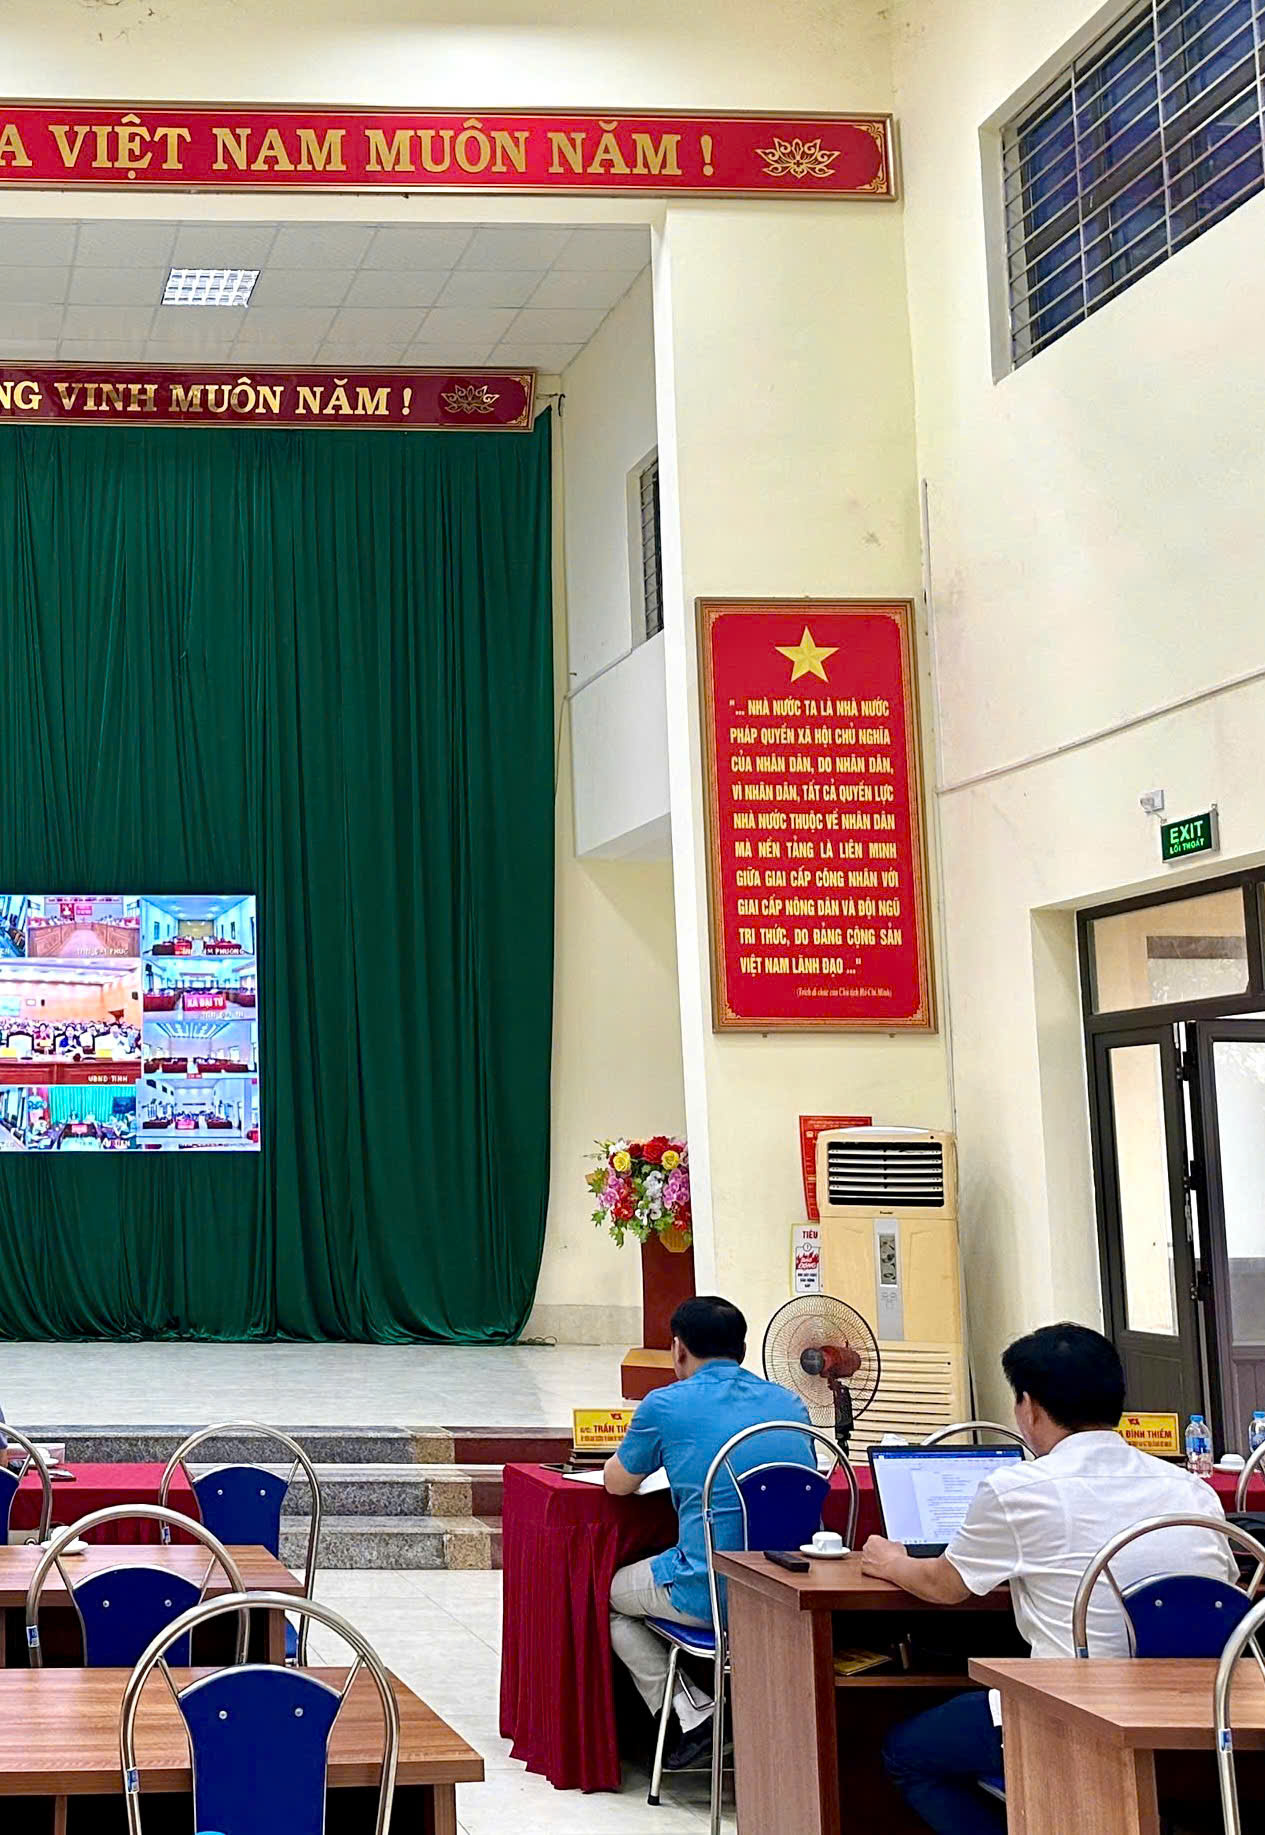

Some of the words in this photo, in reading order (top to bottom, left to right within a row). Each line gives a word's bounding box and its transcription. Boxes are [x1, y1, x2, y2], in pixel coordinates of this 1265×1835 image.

[48, 113, 191, 179] VIỆT
[212, 127, 346, 172] NAM
[365, 119, 530, 174] MUÔN
[547, 120, 682, 177] NĂM
[701, 135, 713, 177] !
[54, 381, 157, 413] VINH
[168, 376, 283, 415] MUÔN
[294, 377, 391, 416] NĂM
[402, 388, 412, 416] !
[748, 697, 770, 716] NHÀ
[773, 696, 801, 716] NƯỚC
[804, 700, 817, 716] TA
[820, 697, 833, 716] LÀ
[837, 697, 858, 716] NHÀ
[861, 697, 889, 716] NƯỚC
[730, 725, 757, 744] PHÁP
[798, 726, 812, 744] XÃ
[815, 725, 832, 747] HỘI
[835, 722, 855, 744] CHỦ
[859, 726, 891, 745] NGHĨA
[731, 750, 752, 772] CỦA
[756, 753, 785, 772] NHÂN
[789, 753, 814, 774] DÂN,
[818, 757, 832, 772] DO
[836, 754, 865, 773] NHÂN
[745, 782, 773, 800] NHÂN
[776, 783, 800, 802] DÂN,
[823, 778, 835, 801] CẢ
[874, 784, 894, 804] LỰC
[734, 810, 755, 829] NHÀ
[758, 810, 787, 829] NƯỚC
[790, 811, 823, 832] THUỘC
[841, 811, 870, 829] NHÂN
[874, 811, 895, 830] DÂN
[1170, 821, 1203, 844] EXIT
[735, 838, 752, 857] MÀ
[787, 835, 814, 858] TẢNG
[820, 839, 833, 858] LÀ
[839, 839, 863, 858] LIÊN
[869, 842, 897, 858] MINH
[737, 867, 761, 886] GIỮA
[765, 871, 786, 887] GIAI
[848, 868, 878, 887] NHÂN
[881, 867, 899, 887] VỚI
[738, 899, 759, 915] GIAI
[786, 897, 814, 916] NÔNG
[818, 897, 839, 916] DÂN
[842, 897, 856, 916] VÀ
[858, 897, 875, 919] ĐỘI
[878, 898, 900, 916] NGŨ
[739, 928, 755, 944] TRI
[760, 924, 790, 947] THỨC,
[795, 929, 808, 944] DO
[813, 922, 842, 944] ĐẢNG
[847, 926, 875, 948] CỘNG
[880, 922, 902, 944] SẢN
[740, 954, 762, 977] VIỆT
[765, 957, 789, 973] NAM
[792, 955, 820, 973] LÃNH
[822, 958, 843, 977] ĐẠO
